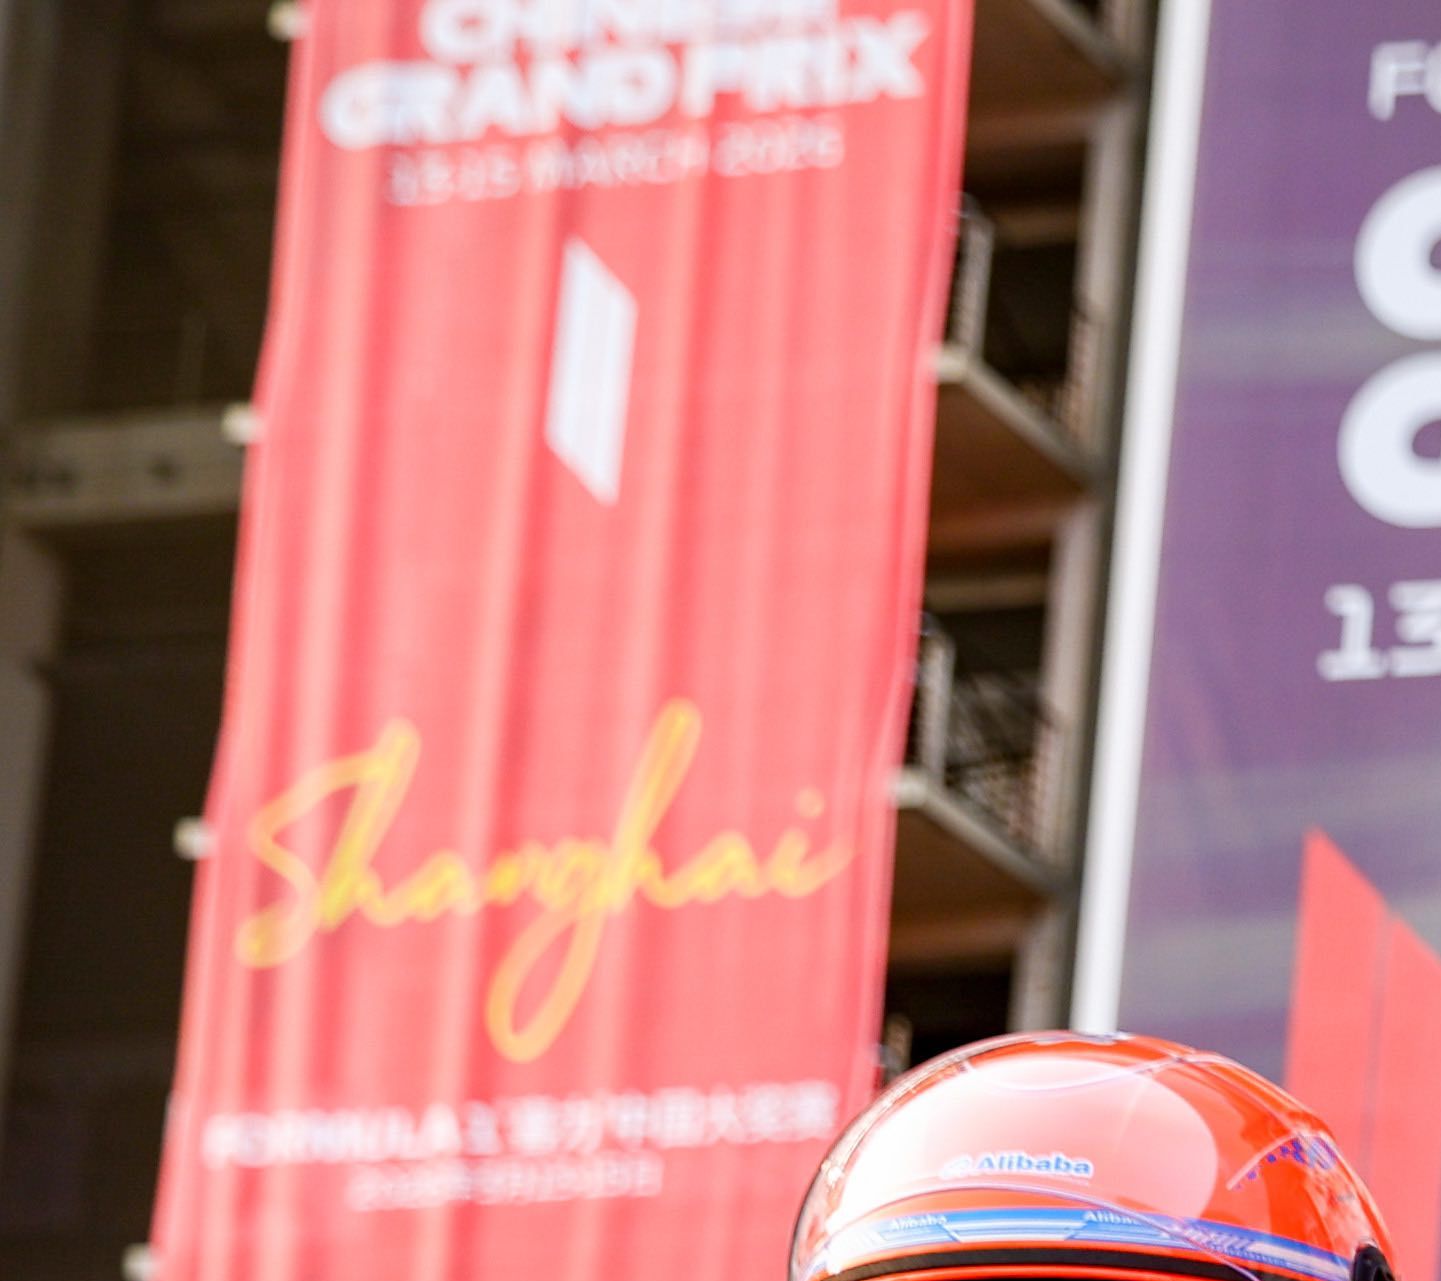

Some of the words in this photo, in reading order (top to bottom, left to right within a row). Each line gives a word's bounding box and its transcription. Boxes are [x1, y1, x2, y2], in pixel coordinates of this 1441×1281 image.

[320, 46, 674, 150] GRAND
[682, 14, 928, 118] PRIX
[233, 697, 856, 1063] Shanghai
[977, 1152, 1093, 1177] Alibaba
